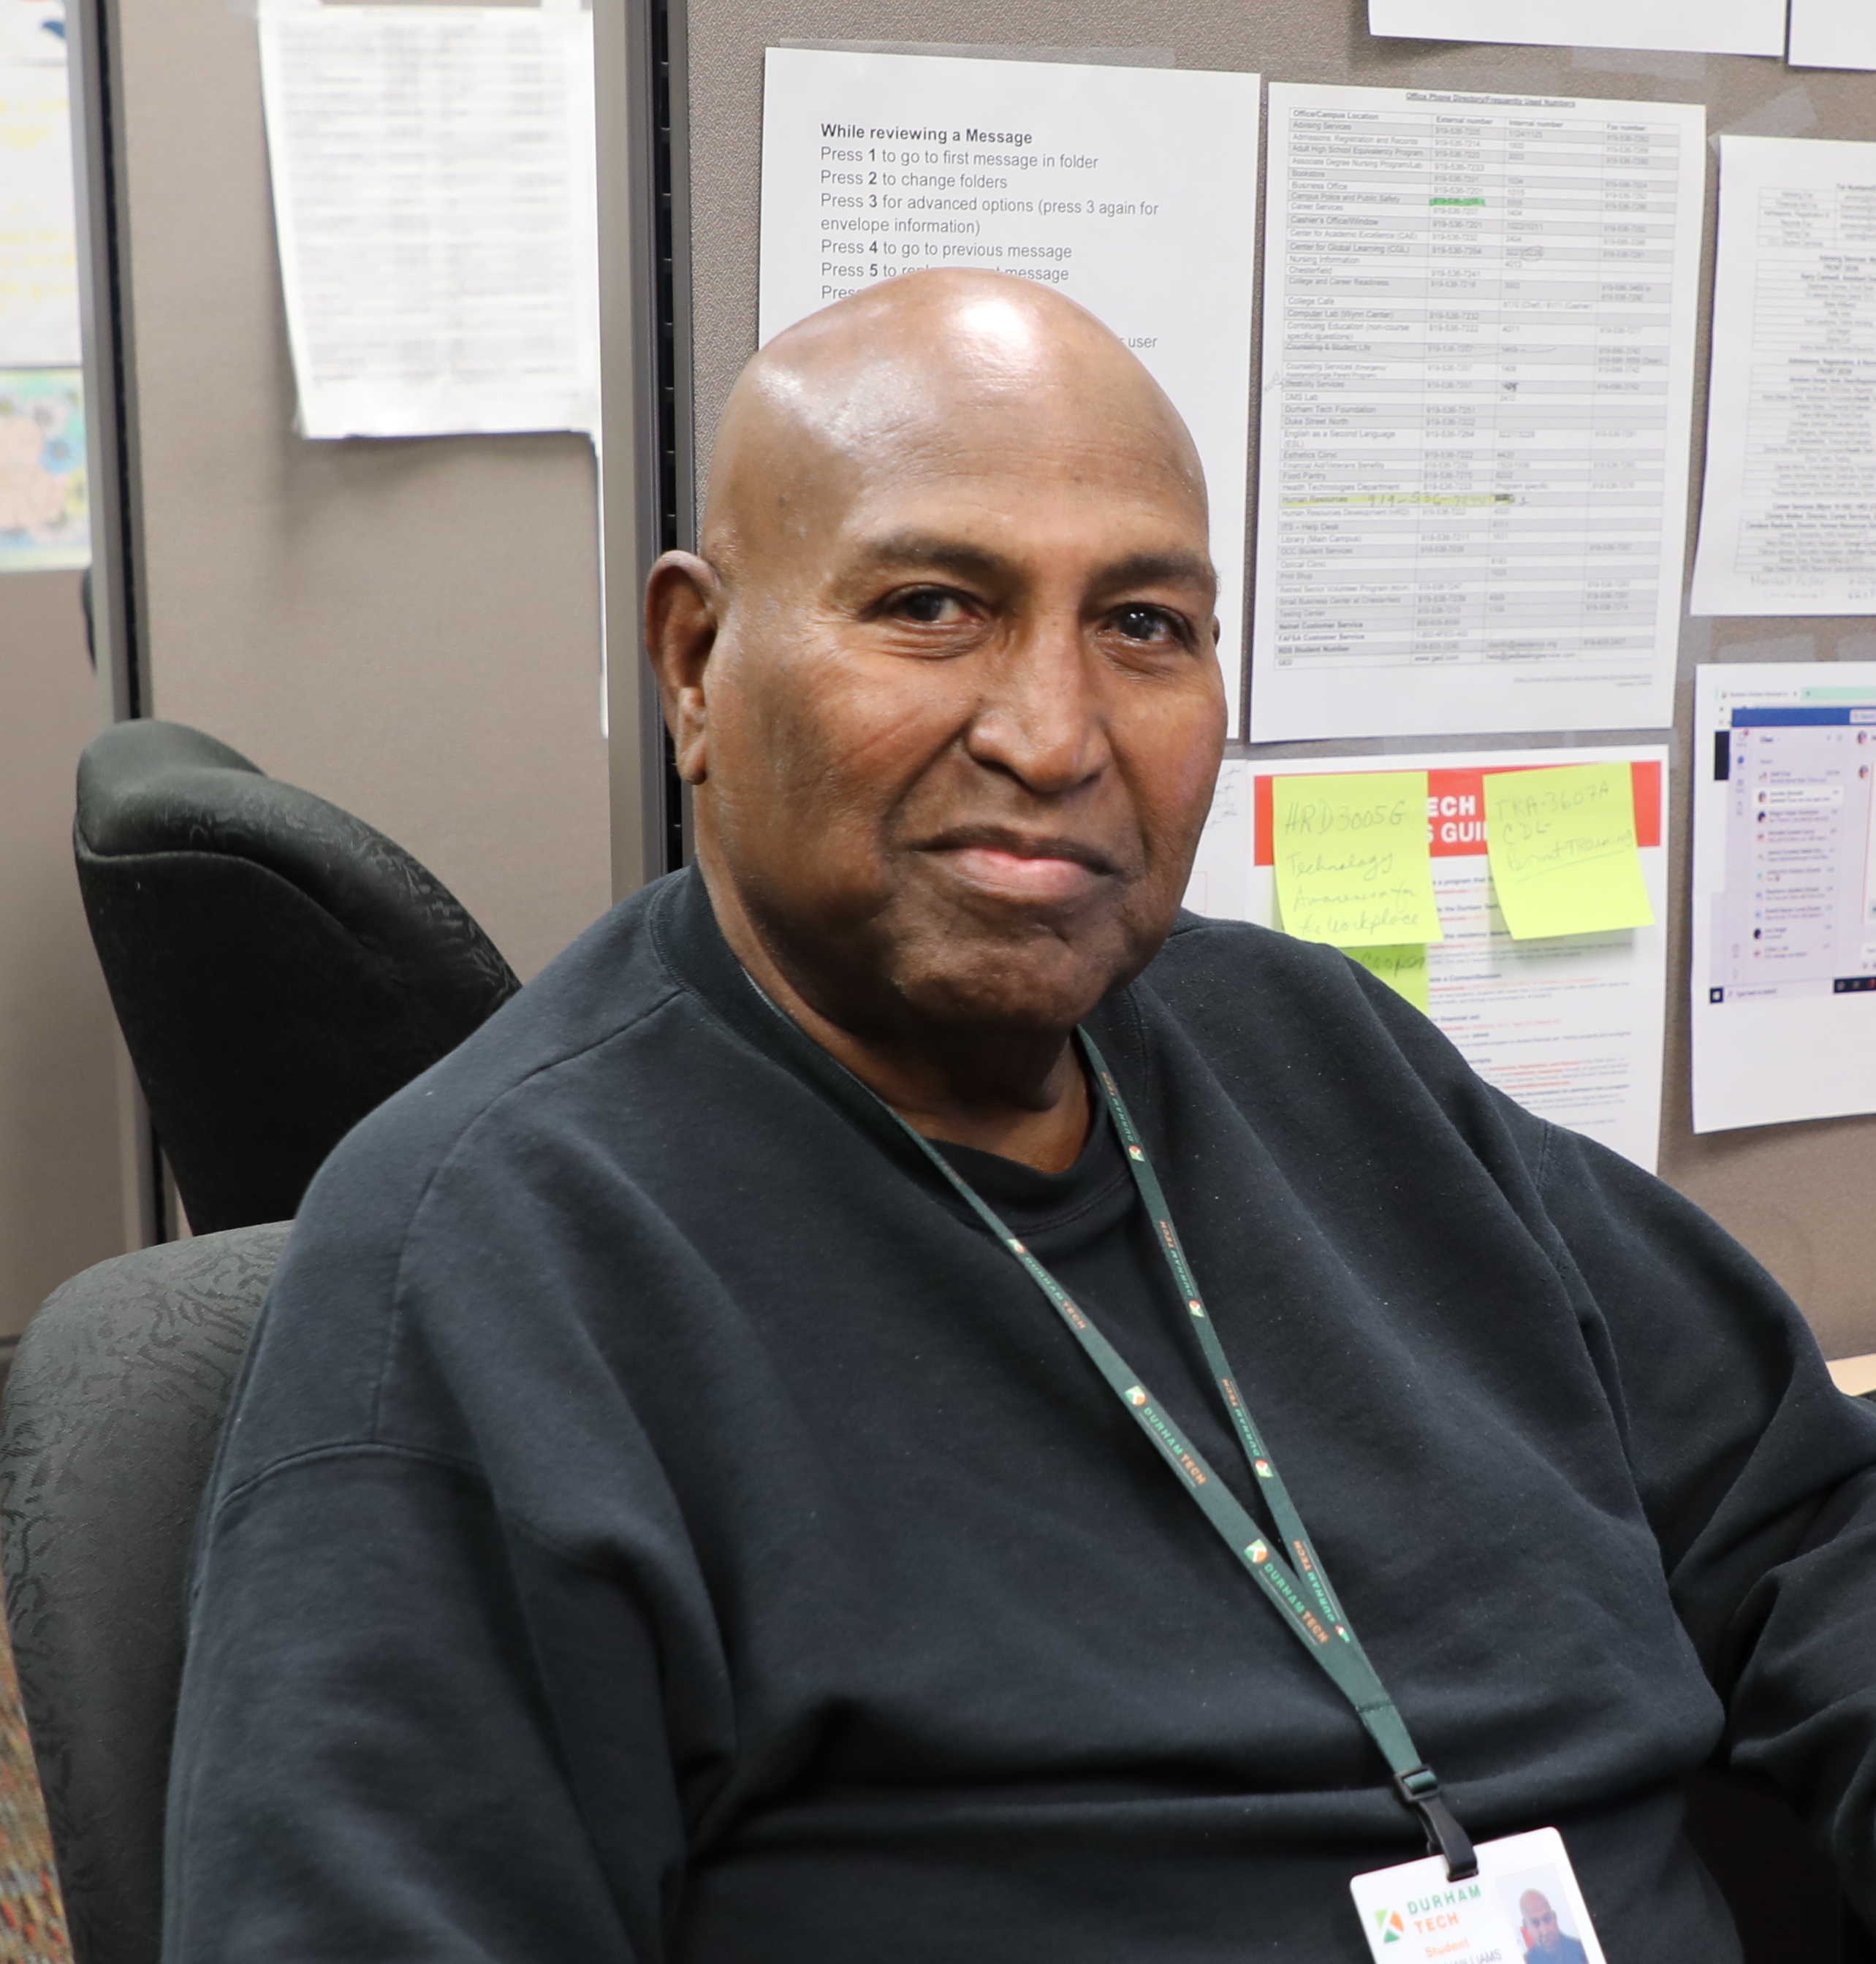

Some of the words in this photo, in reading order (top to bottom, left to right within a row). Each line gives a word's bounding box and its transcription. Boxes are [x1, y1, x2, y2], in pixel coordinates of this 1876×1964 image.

[1293, 110, 1345, 118] Office/Campus
[821, 124, 865, 138] While
[870, 126, 946, 143] reviewing
[953, 132, 960, 140] a
[966, 129, 1032, 146] Message
[821, 147, 863, 161] Press
[870, 149, 876, 161] 1
[883, 150, 895, 161] to
[901, 153, 919, 165] go
[925, 151, 938, 162] to
[943, 151, 968, 164] first
[973, 153, 1038, 170] message
[1043, 154, 1055, 167] in
[1060, 154, 1098, 168] folder
[821, 170, 863, 184] Press
[869, 172, 876, 184] 2
[883, 173, 896, 185] to
[902, 172, 955, 189] change
[960, 175, 1007, 188] folders
[821, 194, 863, 207] Press
[869, 195, 877, 208] 3
[883, 195, 903, 208] for
[908, 197, 976, 209] advanced
[982, 199, 1033, 213] options
[1038, 199, 1082, 215] (press
[1087, 201, 1094, 213] 3
[1099, 201, 1135, 217] again
[1140, 201, 1158, 215] for
[821, 220, 889, 233] envelope
[895, 220, 980, 235] information)
[822, 240, 864, 254] Press
[869, 241, 877, 254] 4
[884, 242, 896, 254] to
[902, 244, 920, 257] go
[924, 242, 938, 254] to
[943, 244, 1003, 258] previous
[1009, 246, 1072, 259] message
[822, 263, 864, 276] Press
[870, 264, 877, 276] 5
[884, 264, 896, 276] to
[822, 286, 860, 299] Pres
[1128, 336, 1158, 348] user
[1427, 795, 1476, 818] ECH
[1221, 1378, 1239, 1407] TECH
[1234, 1408, 1261, 1457] DURHAM
[1144, 1407, 1183, 1455] DURHAM
[1181, 1453, 1207, 1485] TECH
[1293, 1540, 1312, 1571] TECH
[1264, 1563, 1305, 1614] DURHAM
[1302, 1610, 1329, 1643] TECH
[1307, 1571, 1335, 1622] DURHAM
[1407, 1884, 1481, 1915] DURHAM
[1413, 1912, 1459, 1933] TECH
[1424, 1938, 1470, 1957] Student
